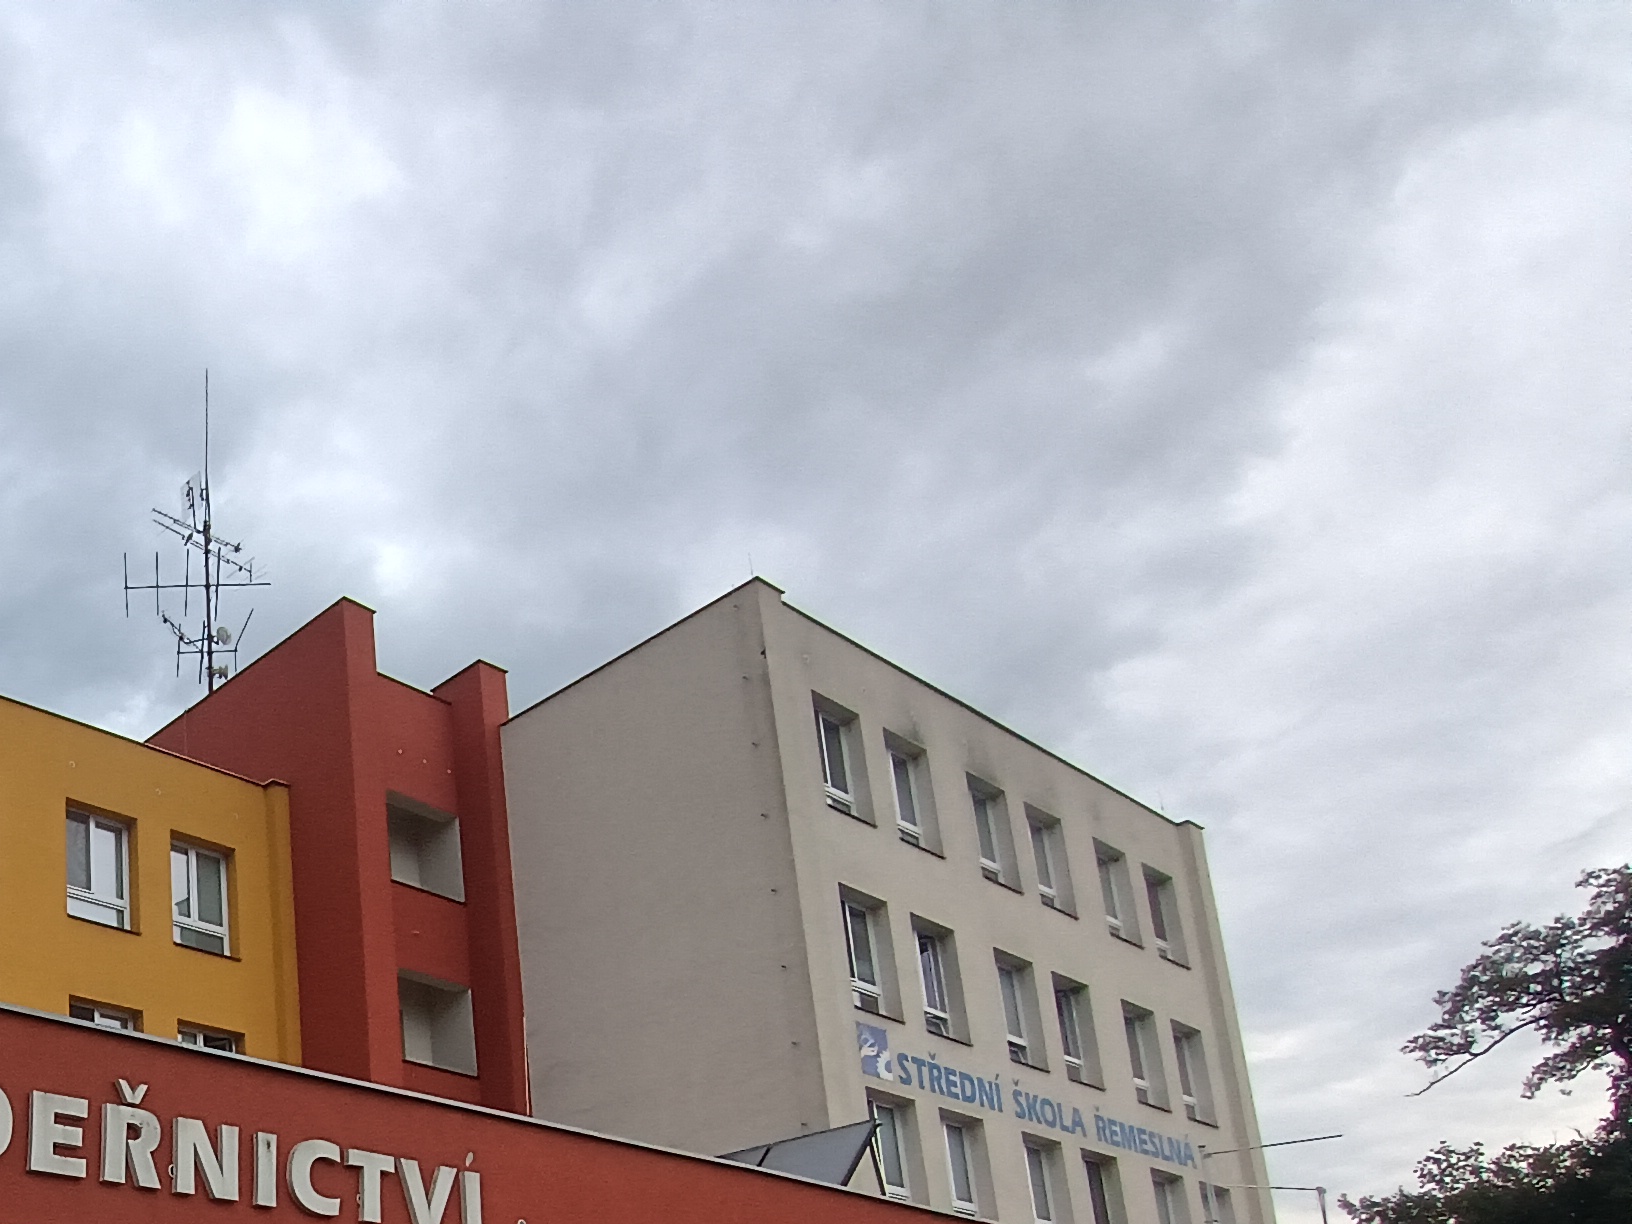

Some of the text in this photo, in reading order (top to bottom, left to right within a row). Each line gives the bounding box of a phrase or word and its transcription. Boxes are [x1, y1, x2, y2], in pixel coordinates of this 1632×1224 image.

[897, 1051, 1197, 1170] STŘEDNÍ ŠKOLA ŘEMESLNÁ
